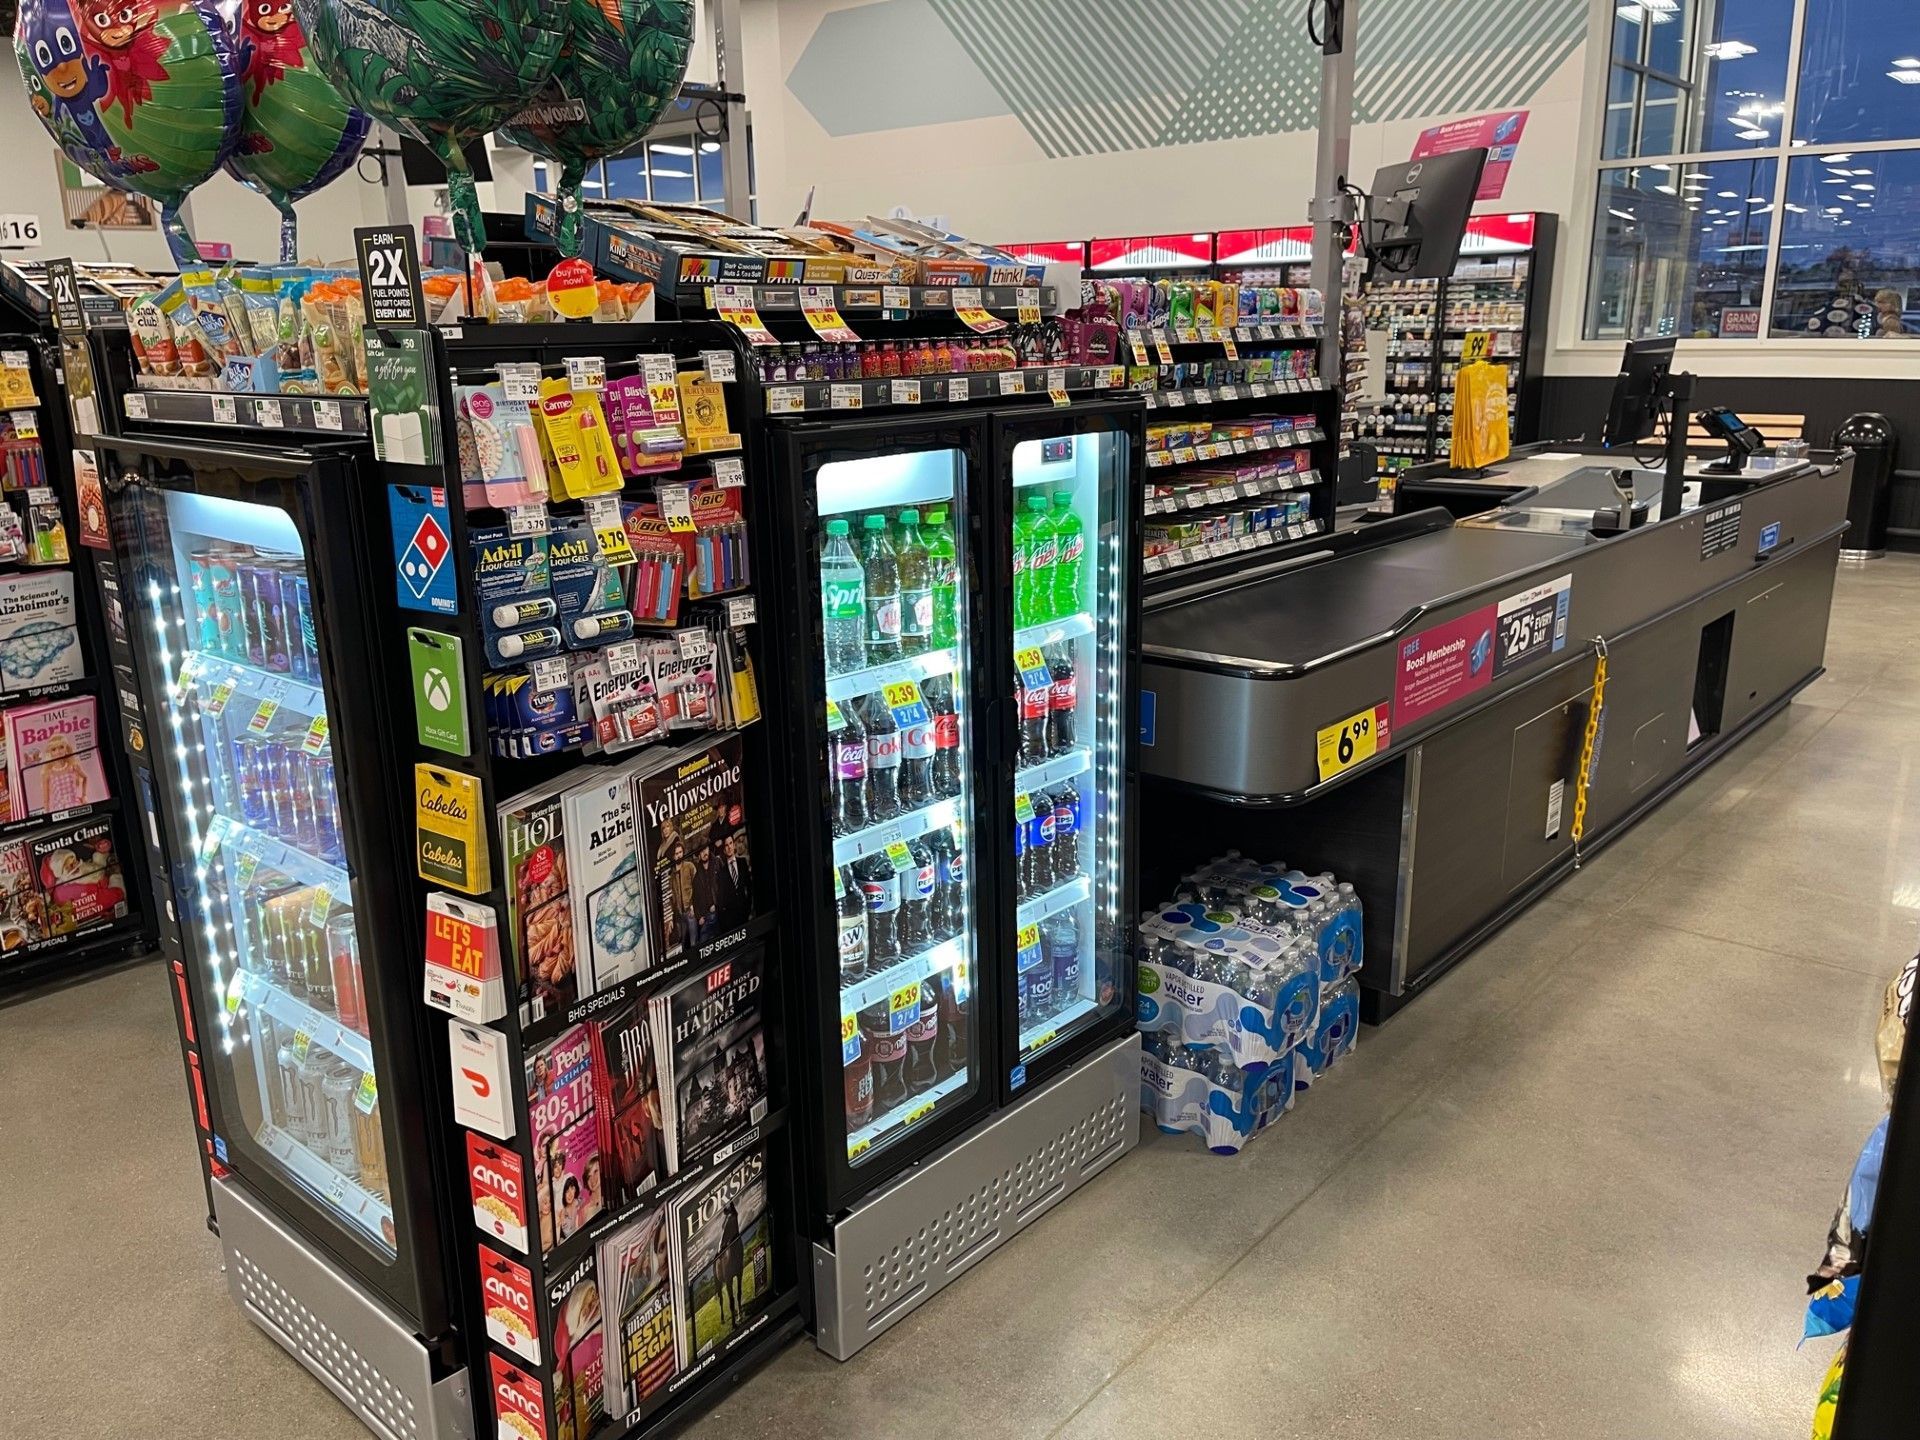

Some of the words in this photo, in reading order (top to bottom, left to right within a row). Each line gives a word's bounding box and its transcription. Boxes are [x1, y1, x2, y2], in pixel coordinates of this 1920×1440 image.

[538, 105, 585, 125] WORLD
[1439, 124, 1454, 135] Boost
[1454, 119, 1486, 131] Membership
[10, 221, 38, 239] 16
[373, 234, 394, 245] EARN
[609, 243, 627, 258] KIND
[369, 249, 408, 286] 2X
[556, 268, 572, 278] buy
[574, 267, 588, 275] me
[723, 269, 736, 277] Nuts
[750, 270, 762, 278] Salt
[724, 262, 737, 270] Dark
[738, 263, 763, 271] Chocolate
[854, 268, 880, 280] QUEST
[563, 277, 584, 286] now!
[992, 267, 1023, 284] think!
[54, 275, 75, 303] 2X
[373, 289, 388, 298] FUEL
[388, 289, 410, 298] POINTS
[394, 299, 411, 308] CARDS
[554, 294, 561, 303] $
[136, 306, 157, 316] snak
[376, 309, 396, 319] EVERY
[964, 311, 984, 321] 1.99
[1020, 308, 1040, 321] 3/5.00
[1726, 312, 1758, 324] GRAND
[138, 317, 157, 327] club
[728, 314, 753, 325] 1.49
[812, 314, 834, 325] 1.49
[1093, 315, 1107, 324] cure
[366, 338, 382, 349] VISA
[403, 338, 415, 349] $50
[659, 373, 672, 382] 3.79
[722, 368, 735, 376] 3.99
[586, 375, 602, 386] 1.29
[522, 385, 538, 395] 3.29
[651, 387, 675, 403] 3.49
[1051, 389, 1067, 400] 3.99
[472, 398, 491, 408] eos
[543, 399, 574, 411] Carmex
[659, 413, 676, 421] SALE
[18, 428, 34, 436] 5.99
[729, 475, 742, 484] 5.99
[527, 520, 545, 530] 3.79
[668, 516, 691, 528] 5.99
[598, 532, 625, 549] 3.79
[480, 542, 524, 564] Advil
[550, 539, 589, 559] Advil
[4, 596, 19, 604] The
[20, 592, 49, 602] Science
[50, 589, 58, 597] of
[519, 603, 540, 613] Advil
[1534, 610, 1553, 631] EVERY
[523, 631, 545, 642] Advil
[1533, 627, 1547, 645] DAY
[692, 644, 707, 654] 9.79
[1403, 638, 1420, 659] FREE
[1406, 655, 1426, 673] Boost
[1426, 637, 1466, 663] Membership
[622, 658, 637, 669] 9.79
[657, 652, 714, 680] Energizer
[1018, 650, 1041, 670] 2.39
[551, 673, 567, 684] 1.19
[593, 660, 648, 702] Energizer
[42, 683, 70, 696] SPECIALS
[606, 691, 620, 702] MAX
[888, 685, 915, 705] 2.39
[533, 694, 555, 706] TUMS
[660, 698, 670, 708] 12
[42, 710, 69, 723] TIME
[22, 716, 91, 746] Barbie
[600, 720, 610, 732] 12
[420, 788, 468, 820] Cabela's
[646, 764, 741, 829] Yellowstone
[601, 808, 620, 824] The
[34, 835, 73, 857] Santa
[73, 823, 110, 842] Claus
[422, 841, 462, 869] Cabela's
[72, 892, 98, 907] STORY
[71, 904, 104, 922] LEGEND
[435, 914, 472, 947] LET'S
[714, 928, 747, 952] SPECIALS
[451, 942, 484, 977] EAT
[663, 959, 689, 974] Specials
[707, 962, 732, 992] LIFE
[893, 986, 919, 1010] 2.39
[1164, 981, 1205, 1007] water
[568, 1005, 587, 1023] BHG
[587, 986, 626, 1013] SPECIALS
[676, 975, 760, 1044] HAUNTED
[702, 1006, 735, 1036] PLACES
[530, 1095, 569, 1132] '80s
[733, 1130, 758, 1149] SPECIALS
[472, 1164, 518, 1199] amc
[686, 1152, 764, 1239] HORSES
[589, 1217, 618, 1239] Meredith
[618, 1202, 644, 1224] Specials
[550, 1253, 594, 1309] Santa
[485, 1275, 530, 1311] amc
[627, 1306, 654, 1337] illiam
[654, 1298, 663, 1313] &
[669, 1364, 702, 1393] Centennial
[498, 1383, 541, 1420] amc
